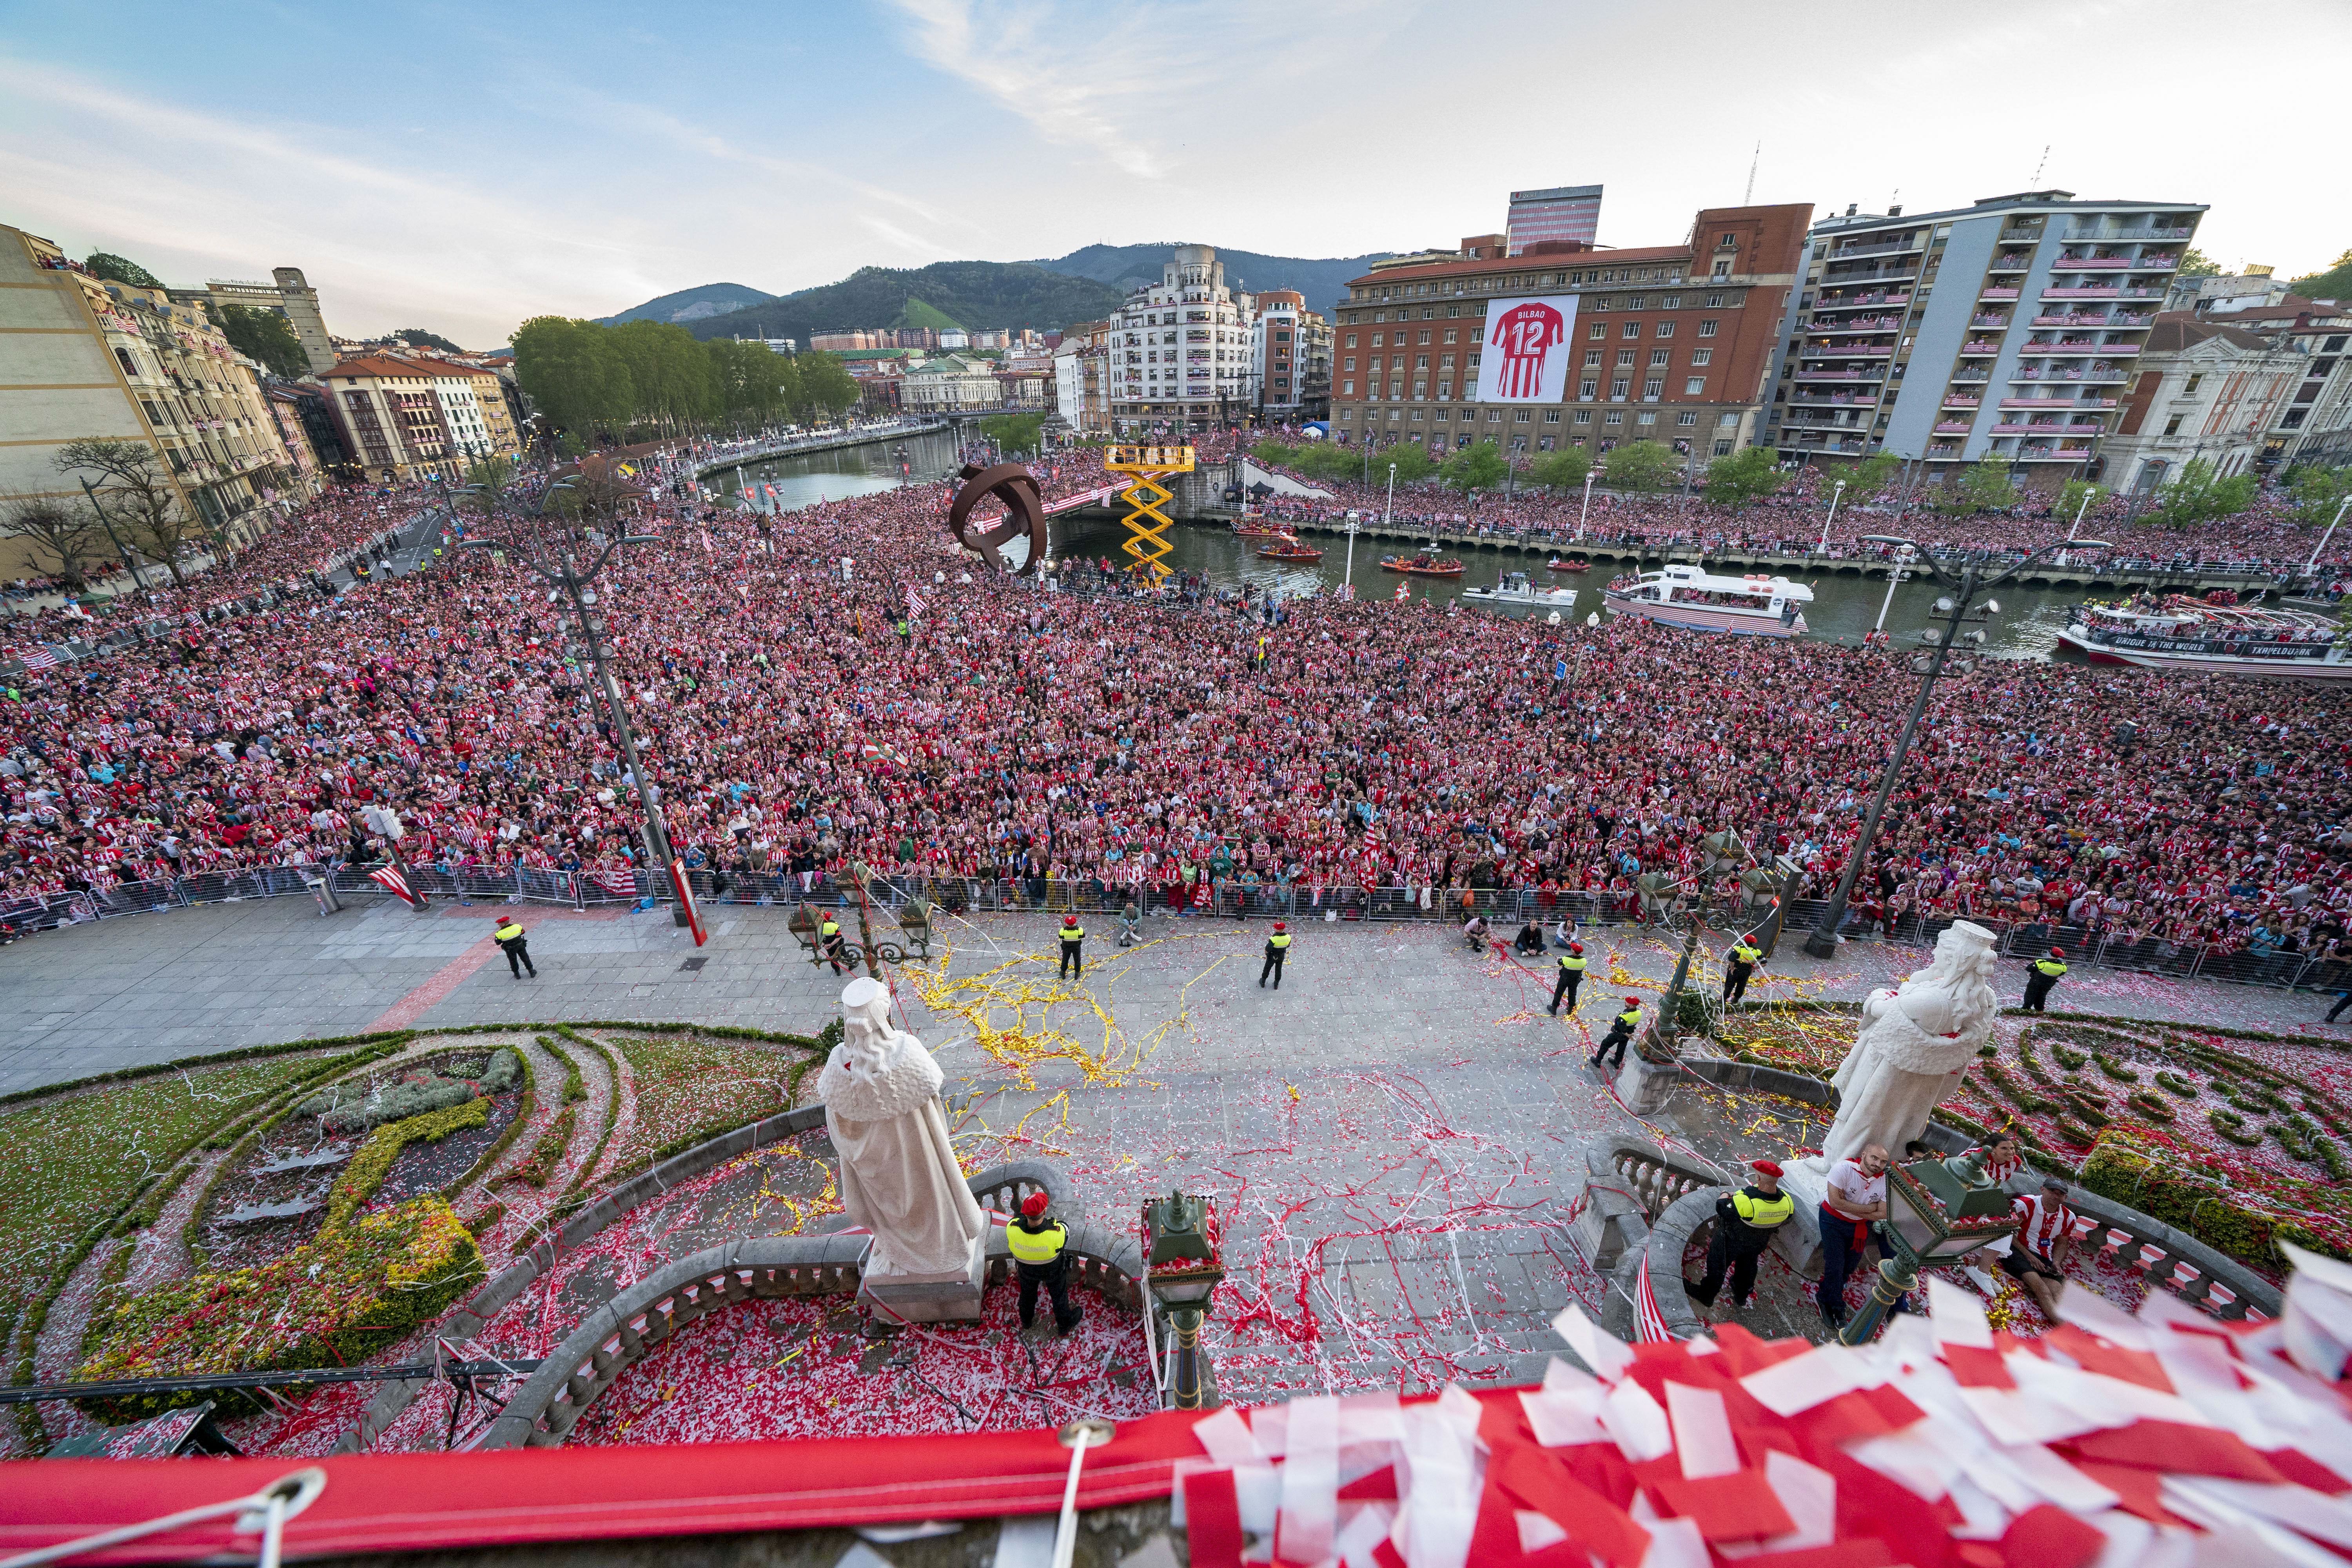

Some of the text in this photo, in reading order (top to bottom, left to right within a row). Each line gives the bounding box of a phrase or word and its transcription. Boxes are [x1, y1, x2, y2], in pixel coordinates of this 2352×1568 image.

[1518, 310, 1545, 319] BILBAO
[1512, 321, 1544, 355] 12
[2116, 637, 2146, 647] UNIQUE
[2176, 642, 2205, 651] WORLD
